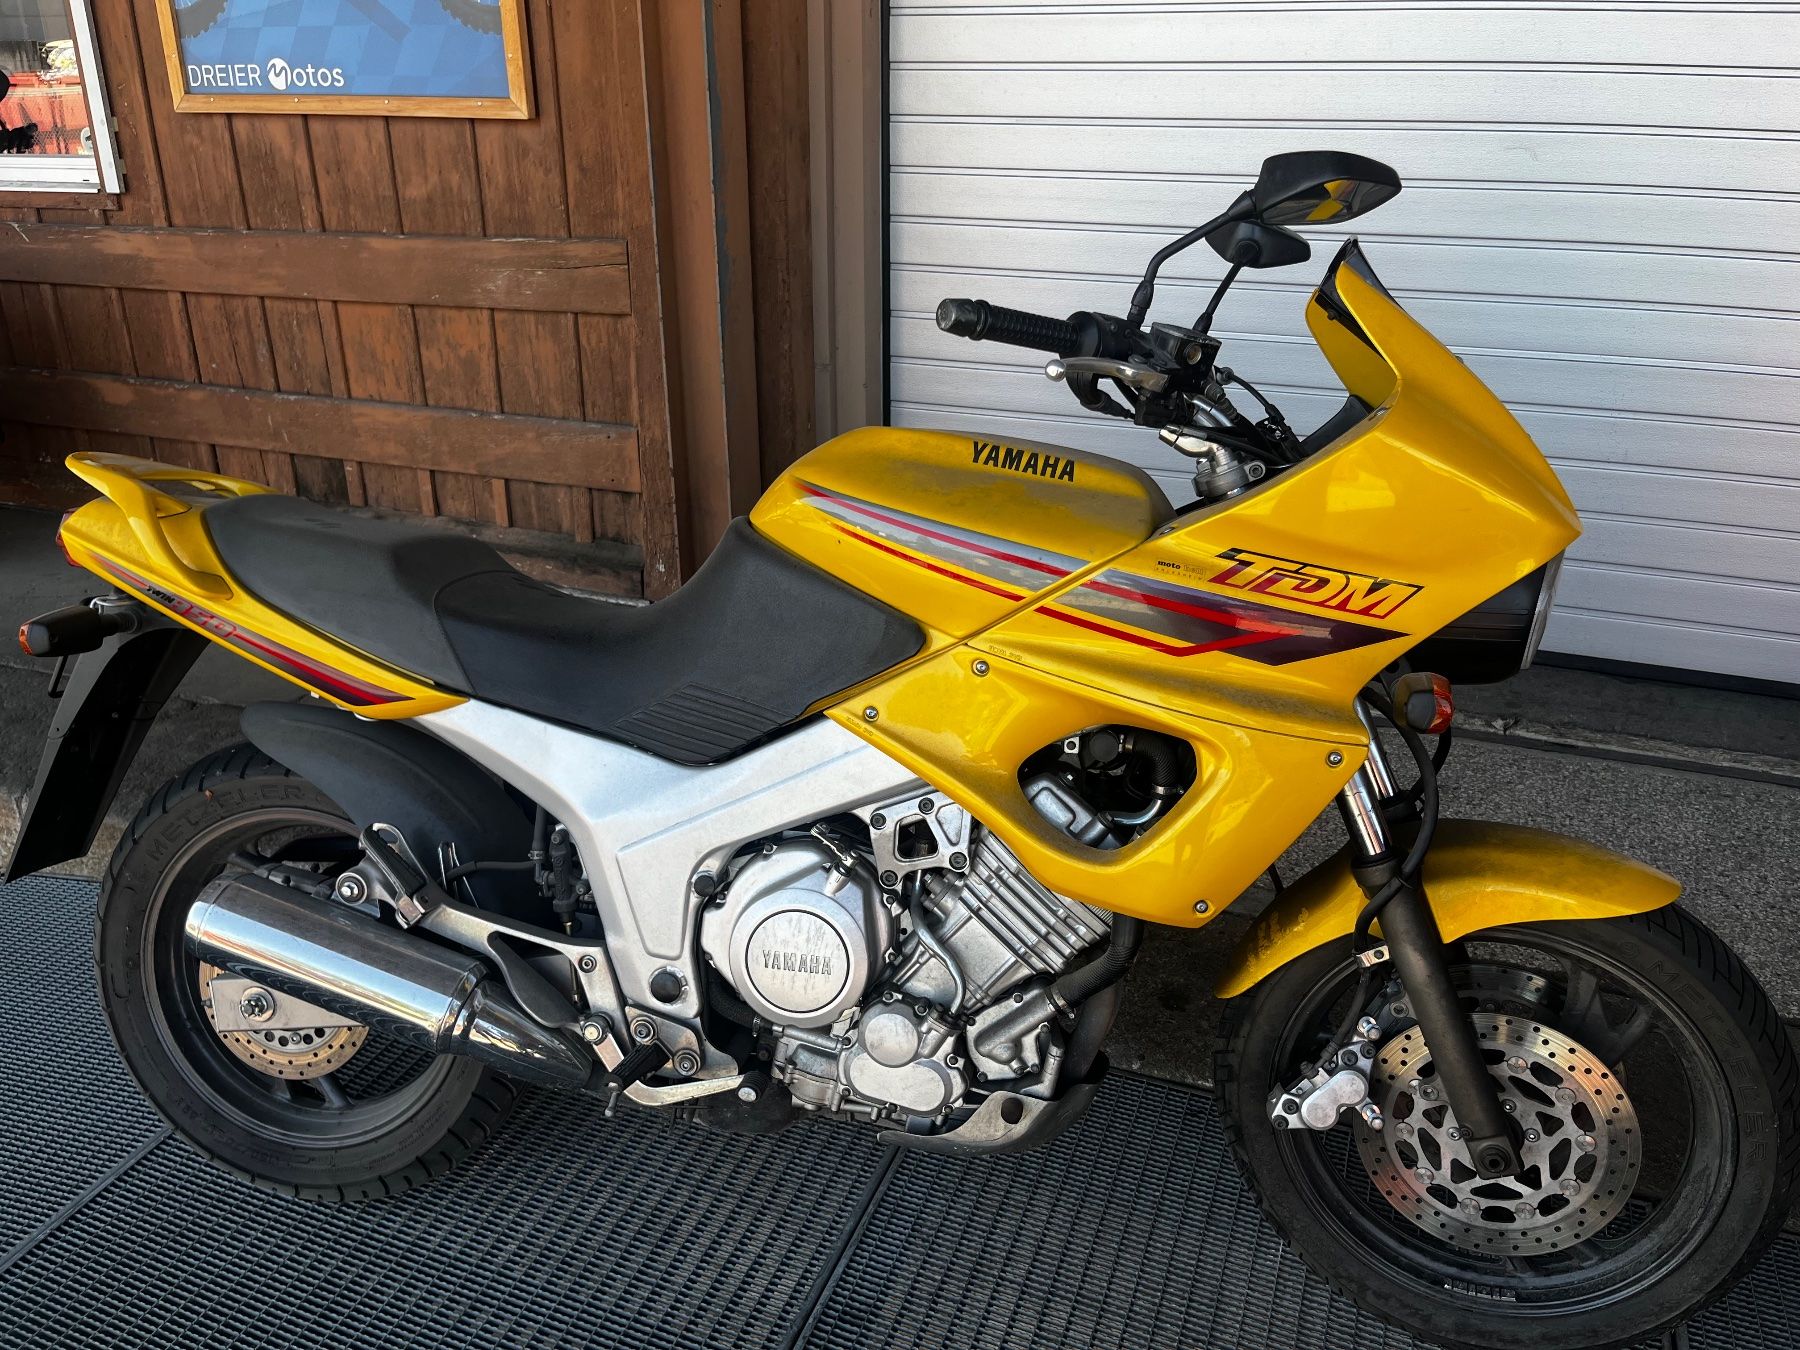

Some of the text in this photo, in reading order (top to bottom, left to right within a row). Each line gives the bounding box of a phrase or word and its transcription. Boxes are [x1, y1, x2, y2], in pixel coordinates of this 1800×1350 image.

[188, 64, 262, 87] DREIER
[973, 441, 1075, 482] YAMAHA
[1157, 560, 1181, 570] moto
[1207, 547, 1425, 619] TDM
[763, 949, 831, 975] YAMAHA
